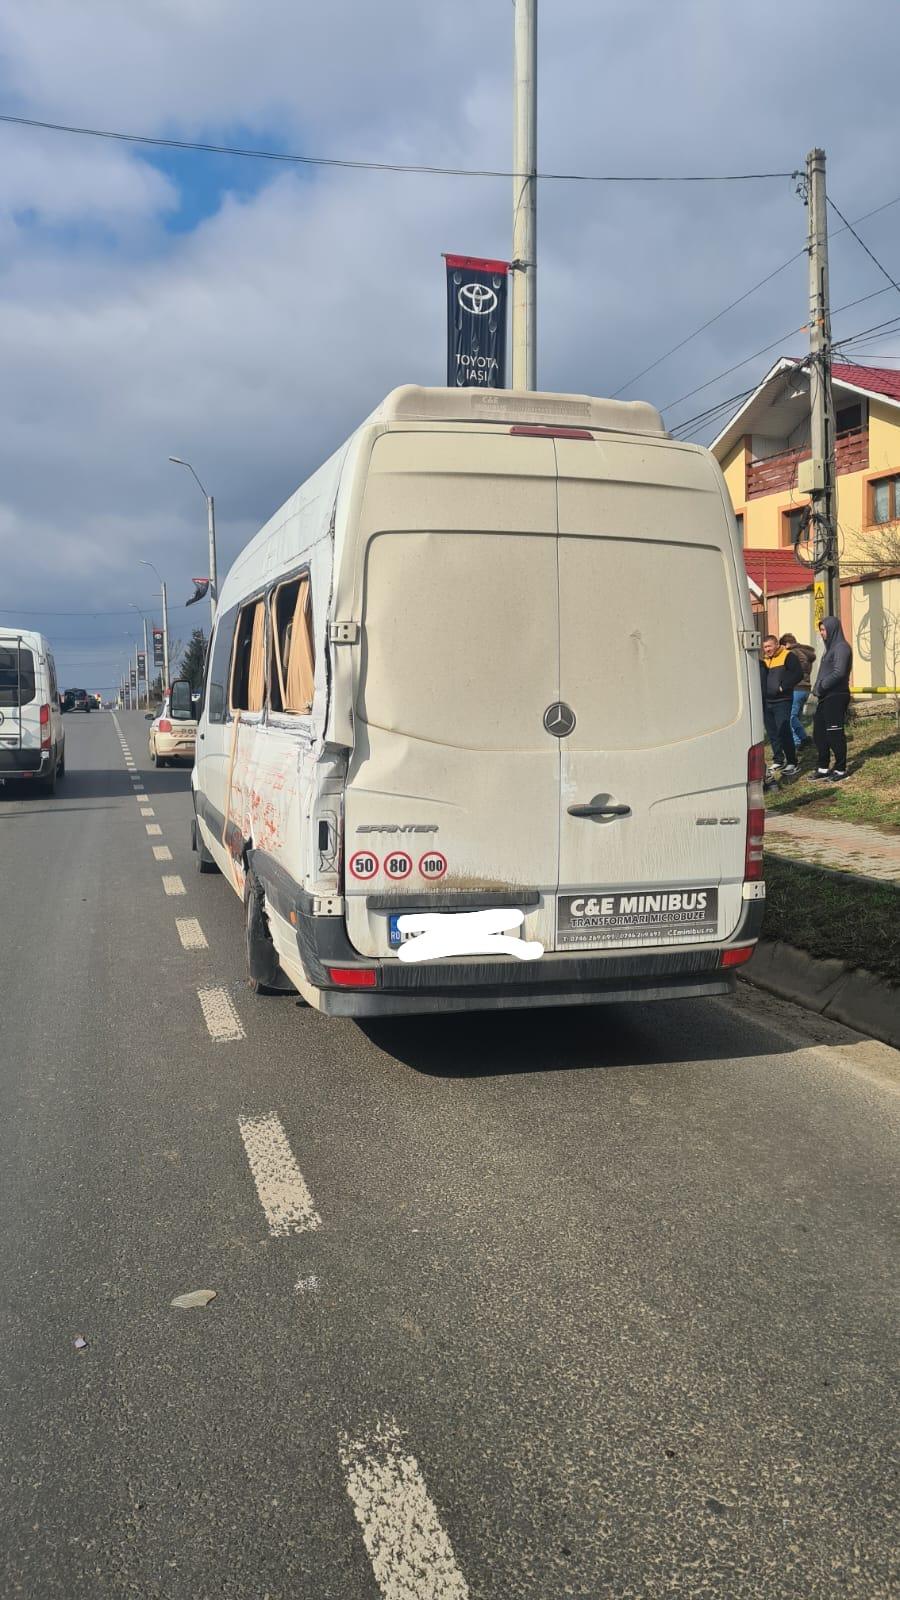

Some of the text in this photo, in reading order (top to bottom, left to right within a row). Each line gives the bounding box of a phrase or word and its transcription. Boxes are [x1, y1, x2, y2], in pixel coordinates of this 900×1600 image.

[456, 354, 498, 369] TOYOTA
[355, 824, 439, 833] SPRINTER
[356, 858, 442, 872] 50 80 100
[570, 892, 707, 917] C&E MINIBUS
[570, 911, 705, 928] TRANSFORMARI MICROBUZE
[390, 931, 401, 940] RO
